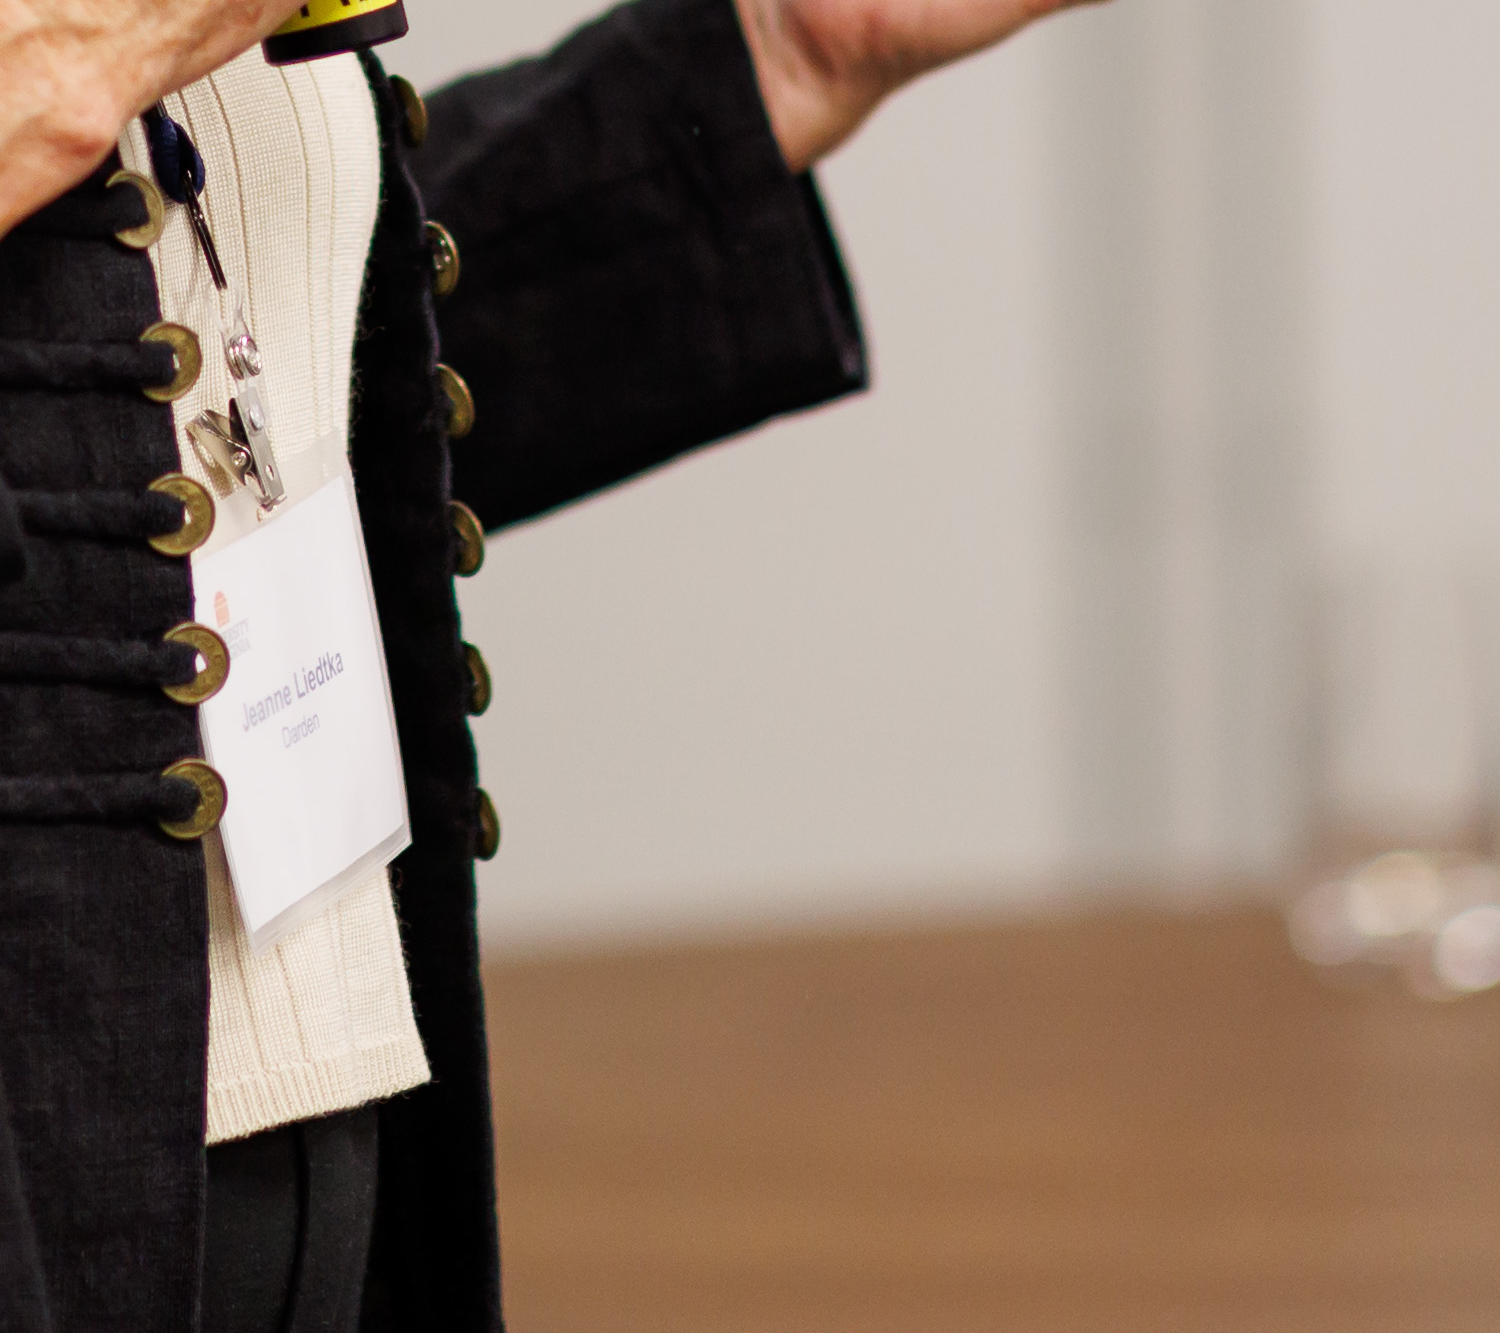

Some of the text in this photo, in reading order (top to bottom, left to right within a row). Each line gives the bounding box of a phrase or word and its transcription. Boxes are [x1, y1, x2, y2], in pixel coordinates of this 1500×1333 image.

[243, 651, 344, 732] Jeanne Liedtka
[281, 714, 320, 749] Darden
